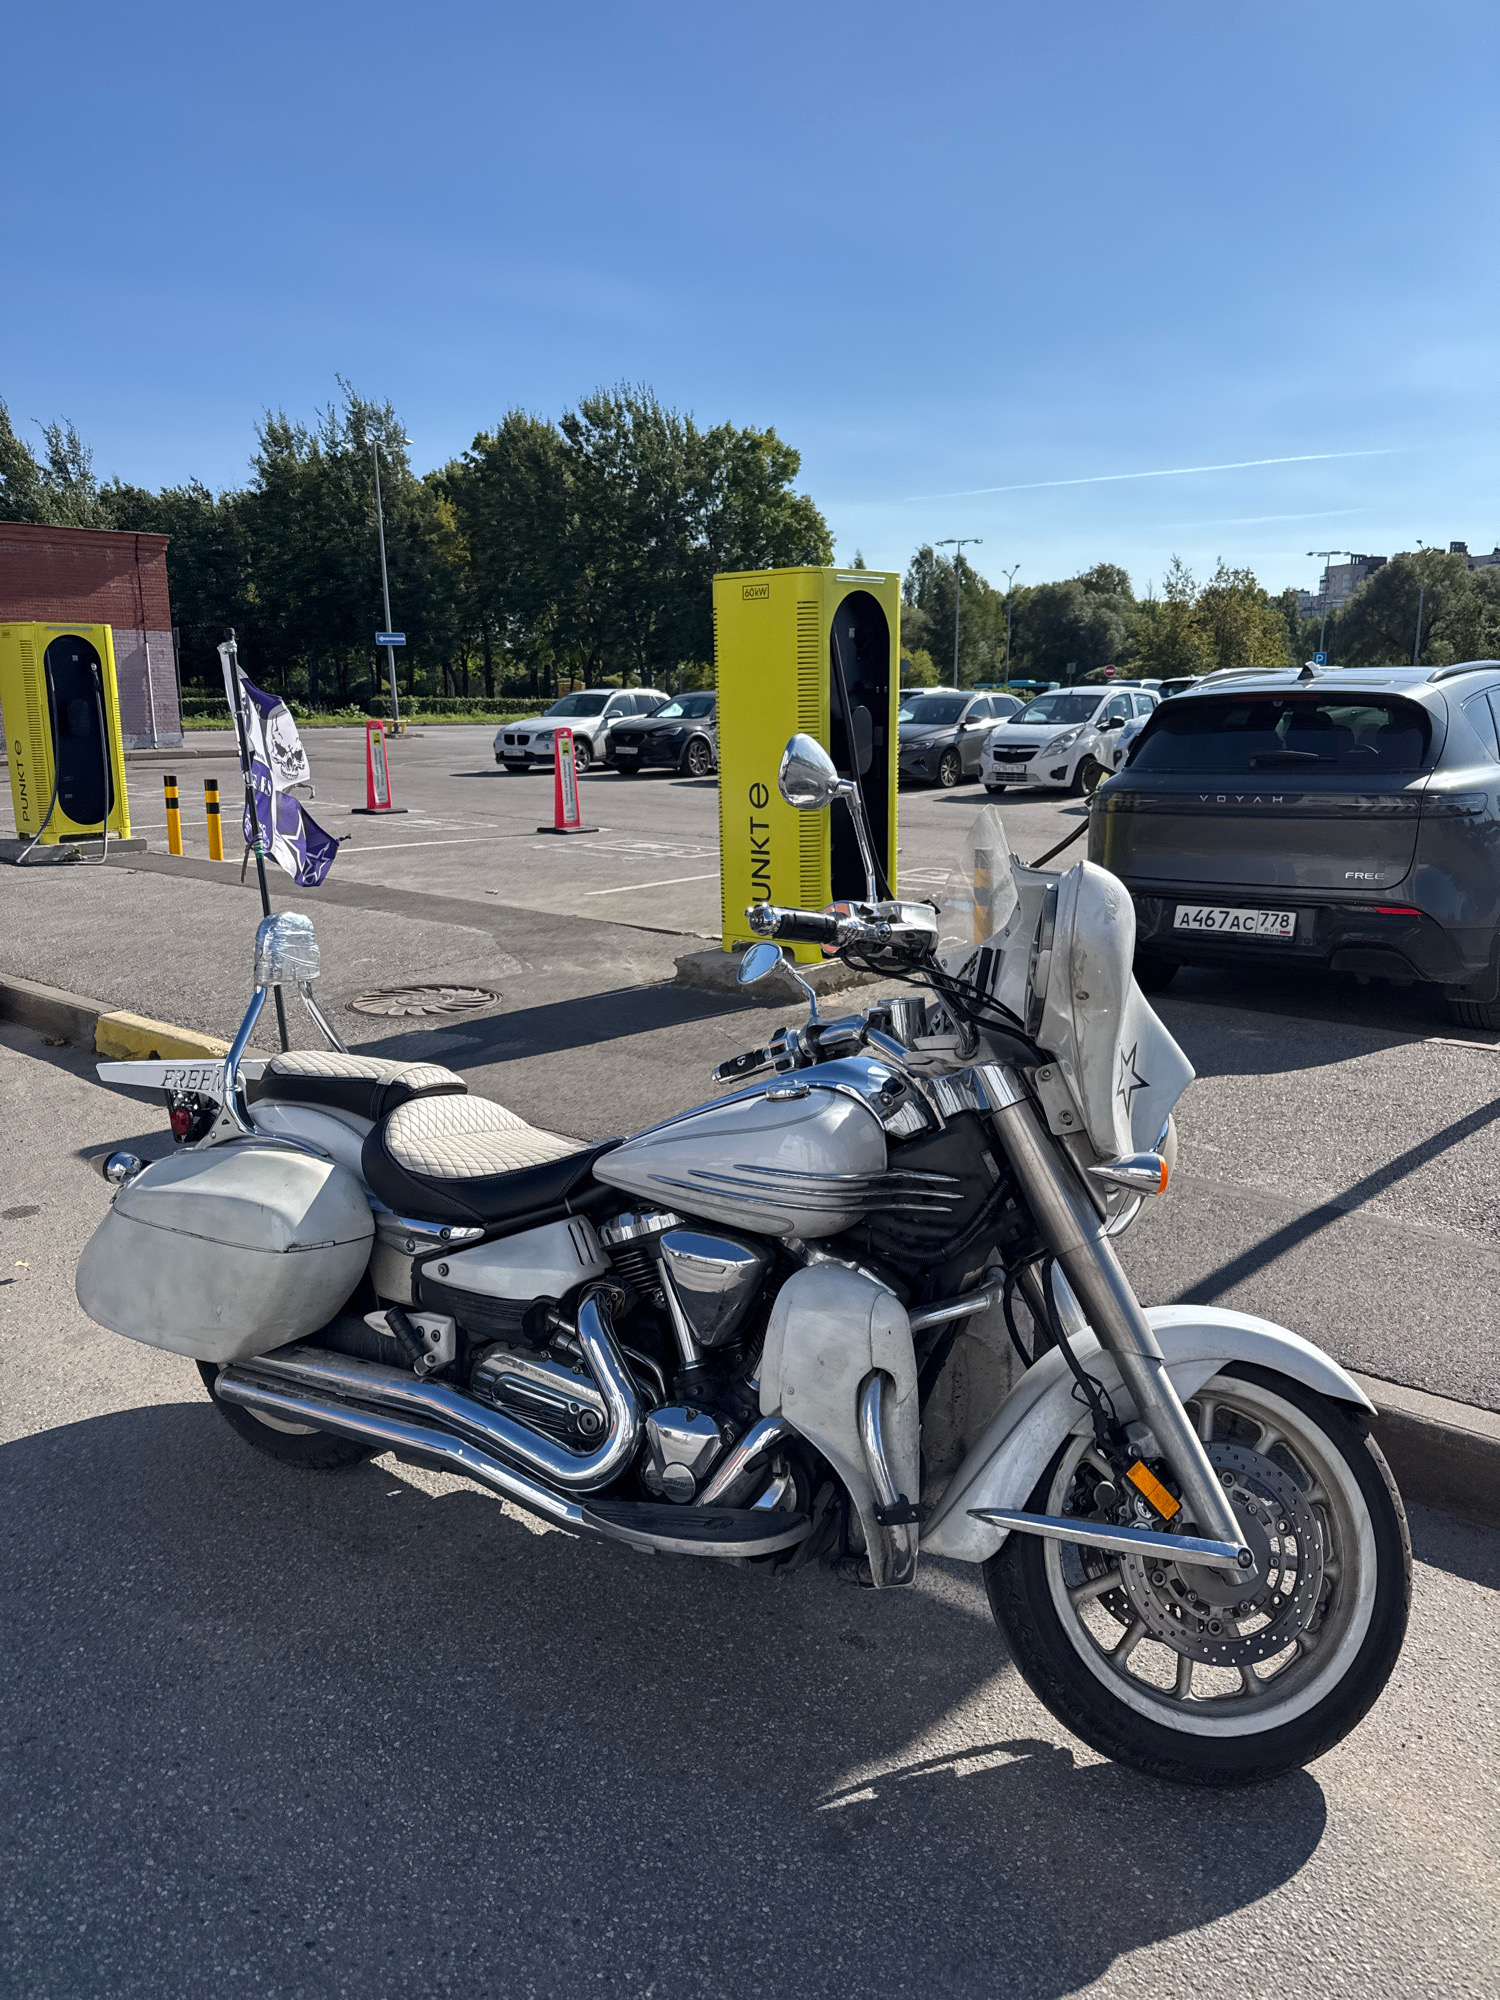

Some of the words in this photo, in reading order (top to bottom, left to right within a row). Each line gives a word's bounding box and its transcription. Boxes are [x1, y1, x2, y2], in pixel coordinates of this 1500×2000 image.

[745, 587, 767, 598] 60kW
[16, 760, 30, 822] PUNKT
[1199, 795, 1283, 803] VOYAH
[749, 816, 772, 907] UNKT
[1344, 872, 1385, 880] FREE
[1260, 912, 1290, 929] 778
